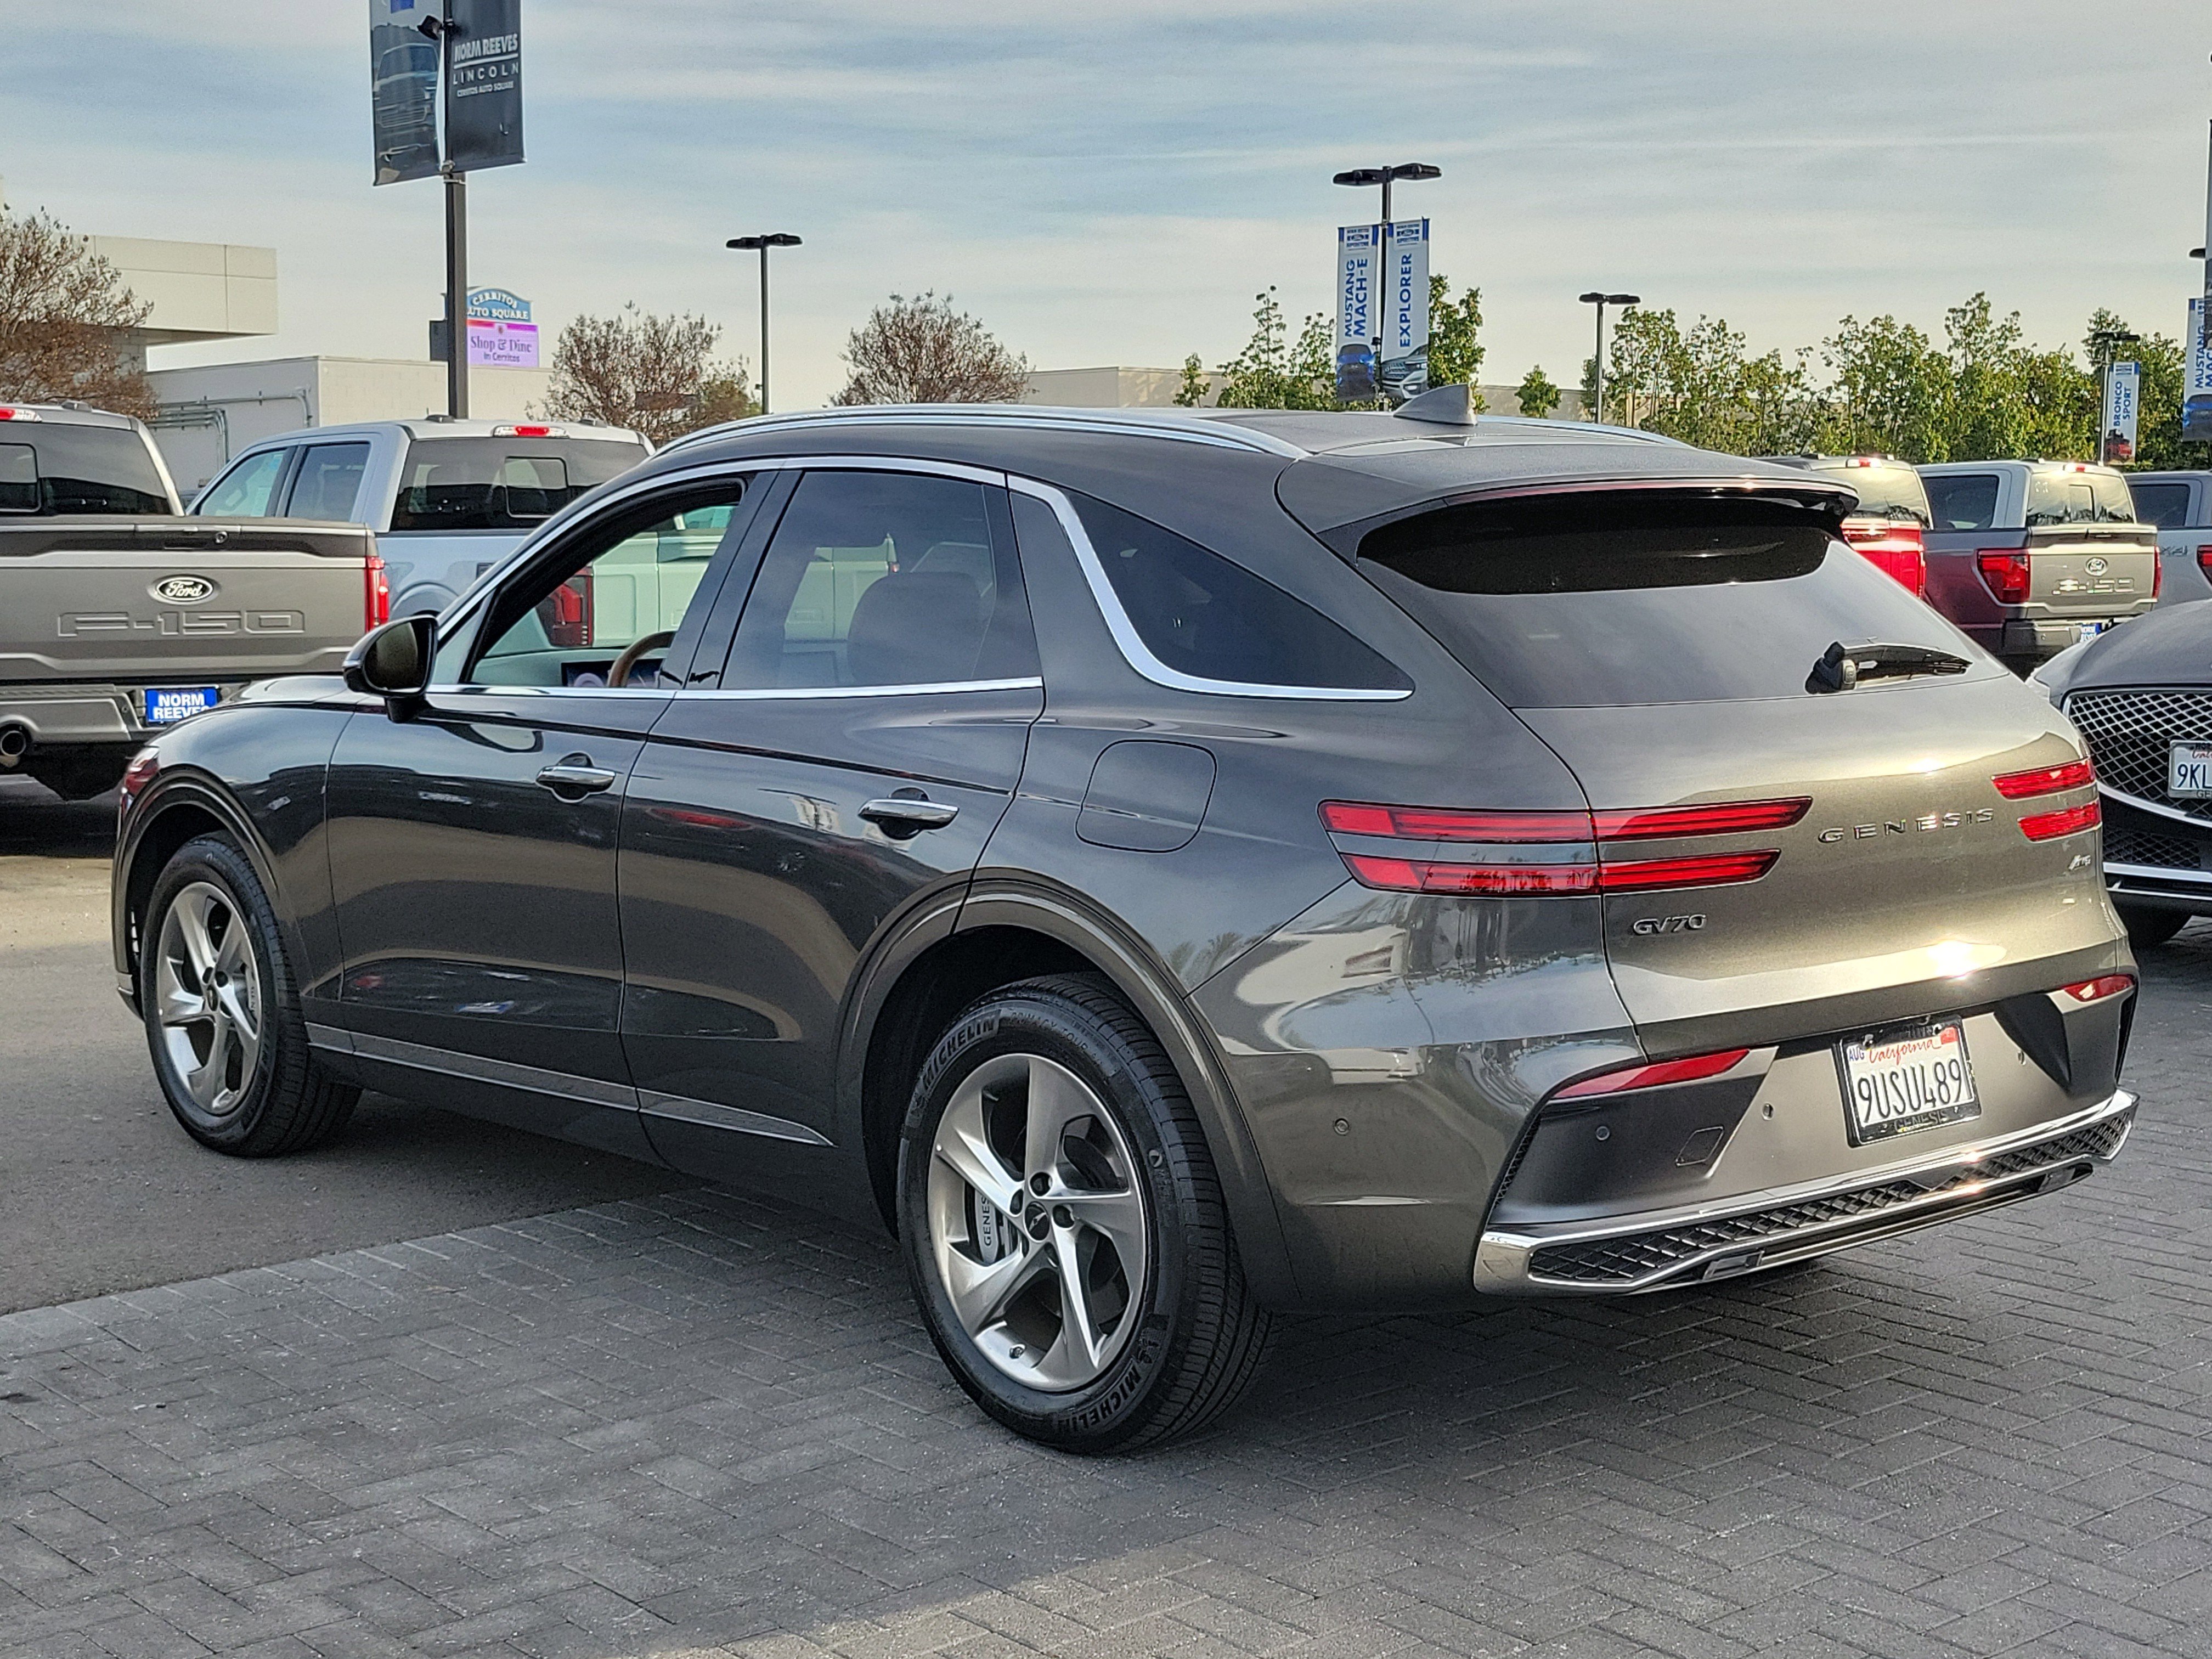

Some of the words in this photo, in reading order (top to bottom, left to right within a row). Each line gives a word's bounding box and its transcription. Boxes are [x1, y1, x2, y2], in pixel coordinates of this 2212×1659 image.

[454, 40, 482, 63] NORM
[482, 33, 518, 55] REEVES
[453, 62, 518, 85] LINCOLN
[472, 292, 517, 309] CERRITOS
[1344, 259, 1355, 337] MUSTANG
[1353, 258, 1368, 336] MACH-E
[1400, 253, 1412, 347] EXPLORER
[491, 308, 528, 319] SQUARE
[471, 335, 496, 352] Shop
[497, 338, 507, 351] &
[509, 339, 532, 353] Dine
[2113, 381, 2122, 426] BRONCO
[2123, 387, 2131, 420] SPORT
[166, 580, 204, 597] Ford
[58, 610, 305, 637] F-150
[158, 693, 205, 707] NORM
[2177, 763, 2212, 789] 9KL
[1818, 808, 1994, 843] GENESIS
[1633, 913, 1706, 935] GV70
[922, 1017, 996, 1091] MICHELIN
[1849, 1049, 1865, 1062] AUG
[1869, 1039, 1942, 1065] California
[1857, 1058, 1962, 1124] 9USU489
[1894, 1109, 1948, 1132] GENESIS
